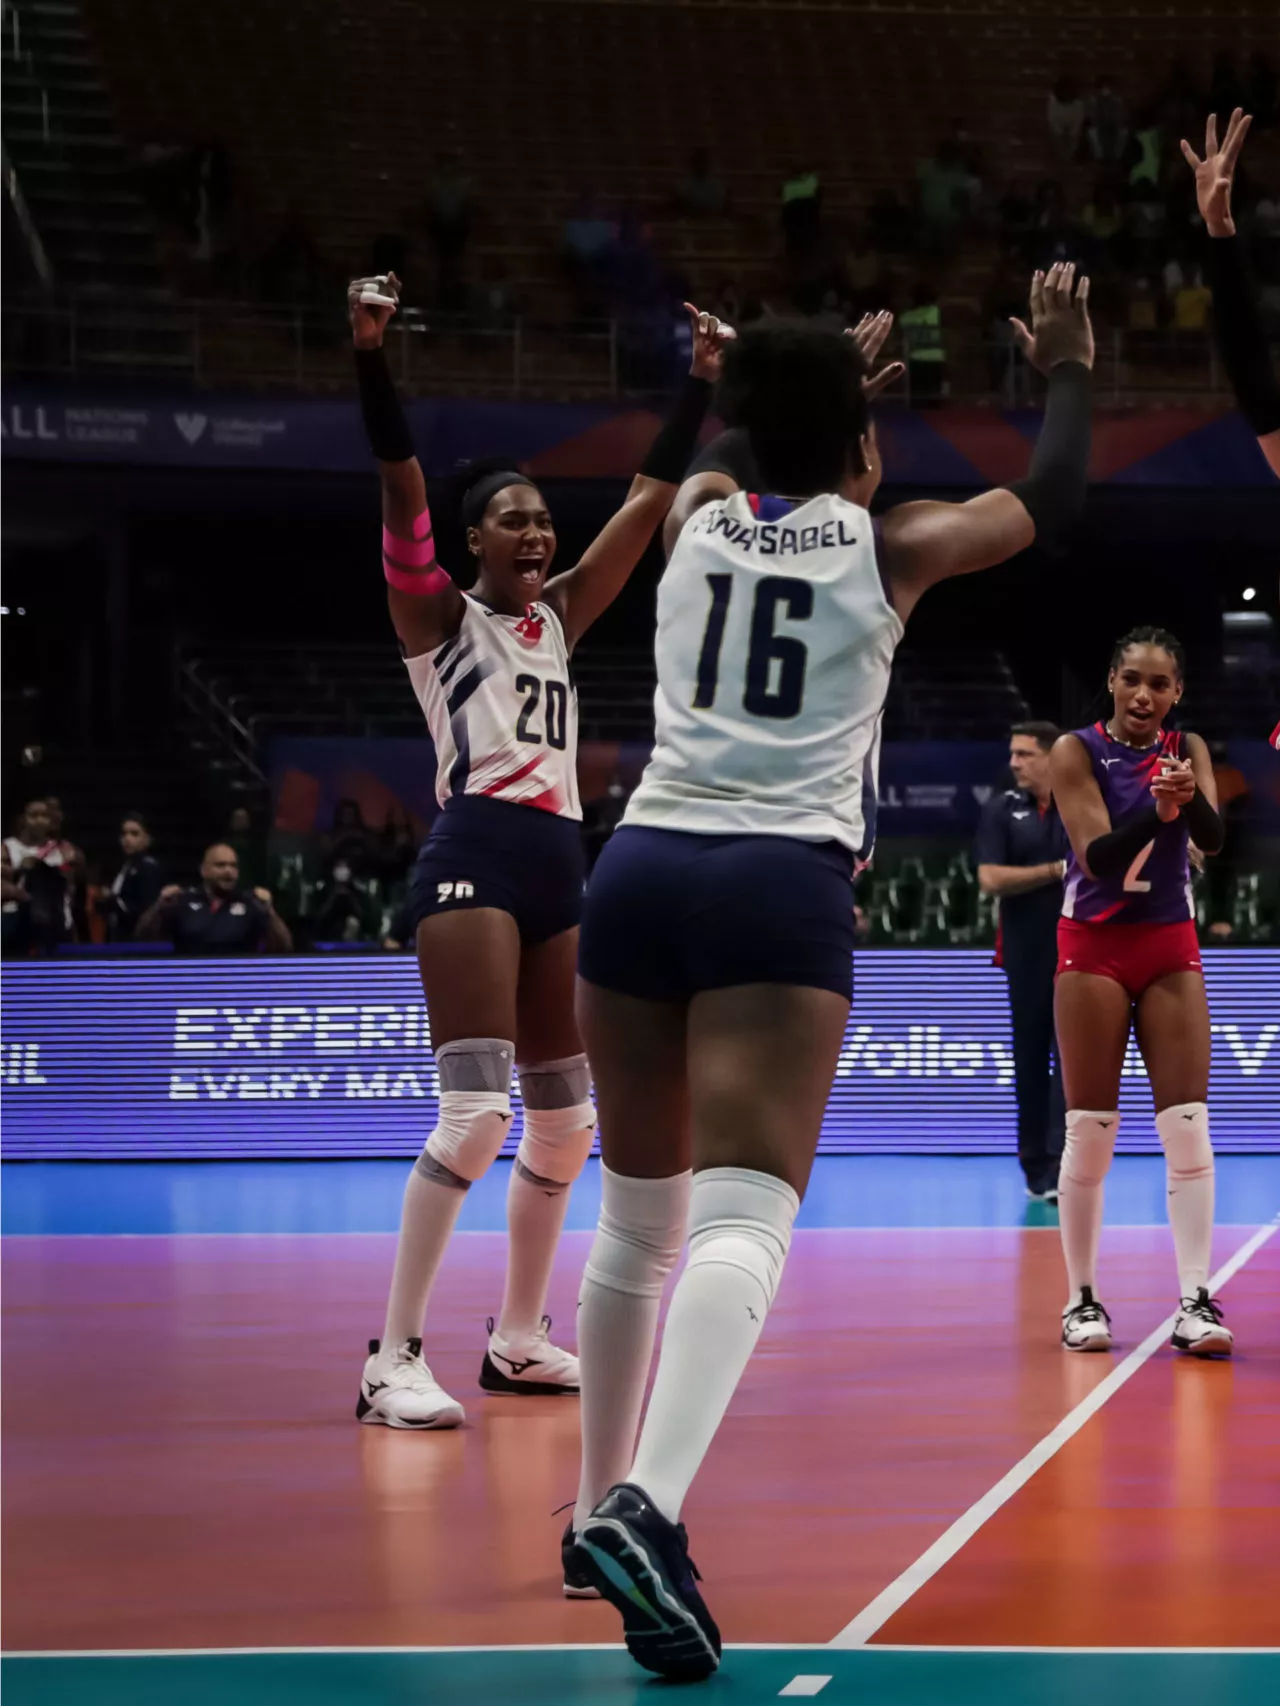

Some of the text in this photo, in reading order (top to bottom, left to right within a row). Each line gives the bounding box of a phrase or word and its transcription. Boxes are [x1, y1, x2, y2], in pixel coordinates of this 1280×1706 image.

[1, 404, 60, 440] LL
[692, 573, 814, 718] 16
[516, 674, 567, 751] 20
[1122, 838, 1156, 893] 2
[168, 1067, 330, 1100] EVERY
